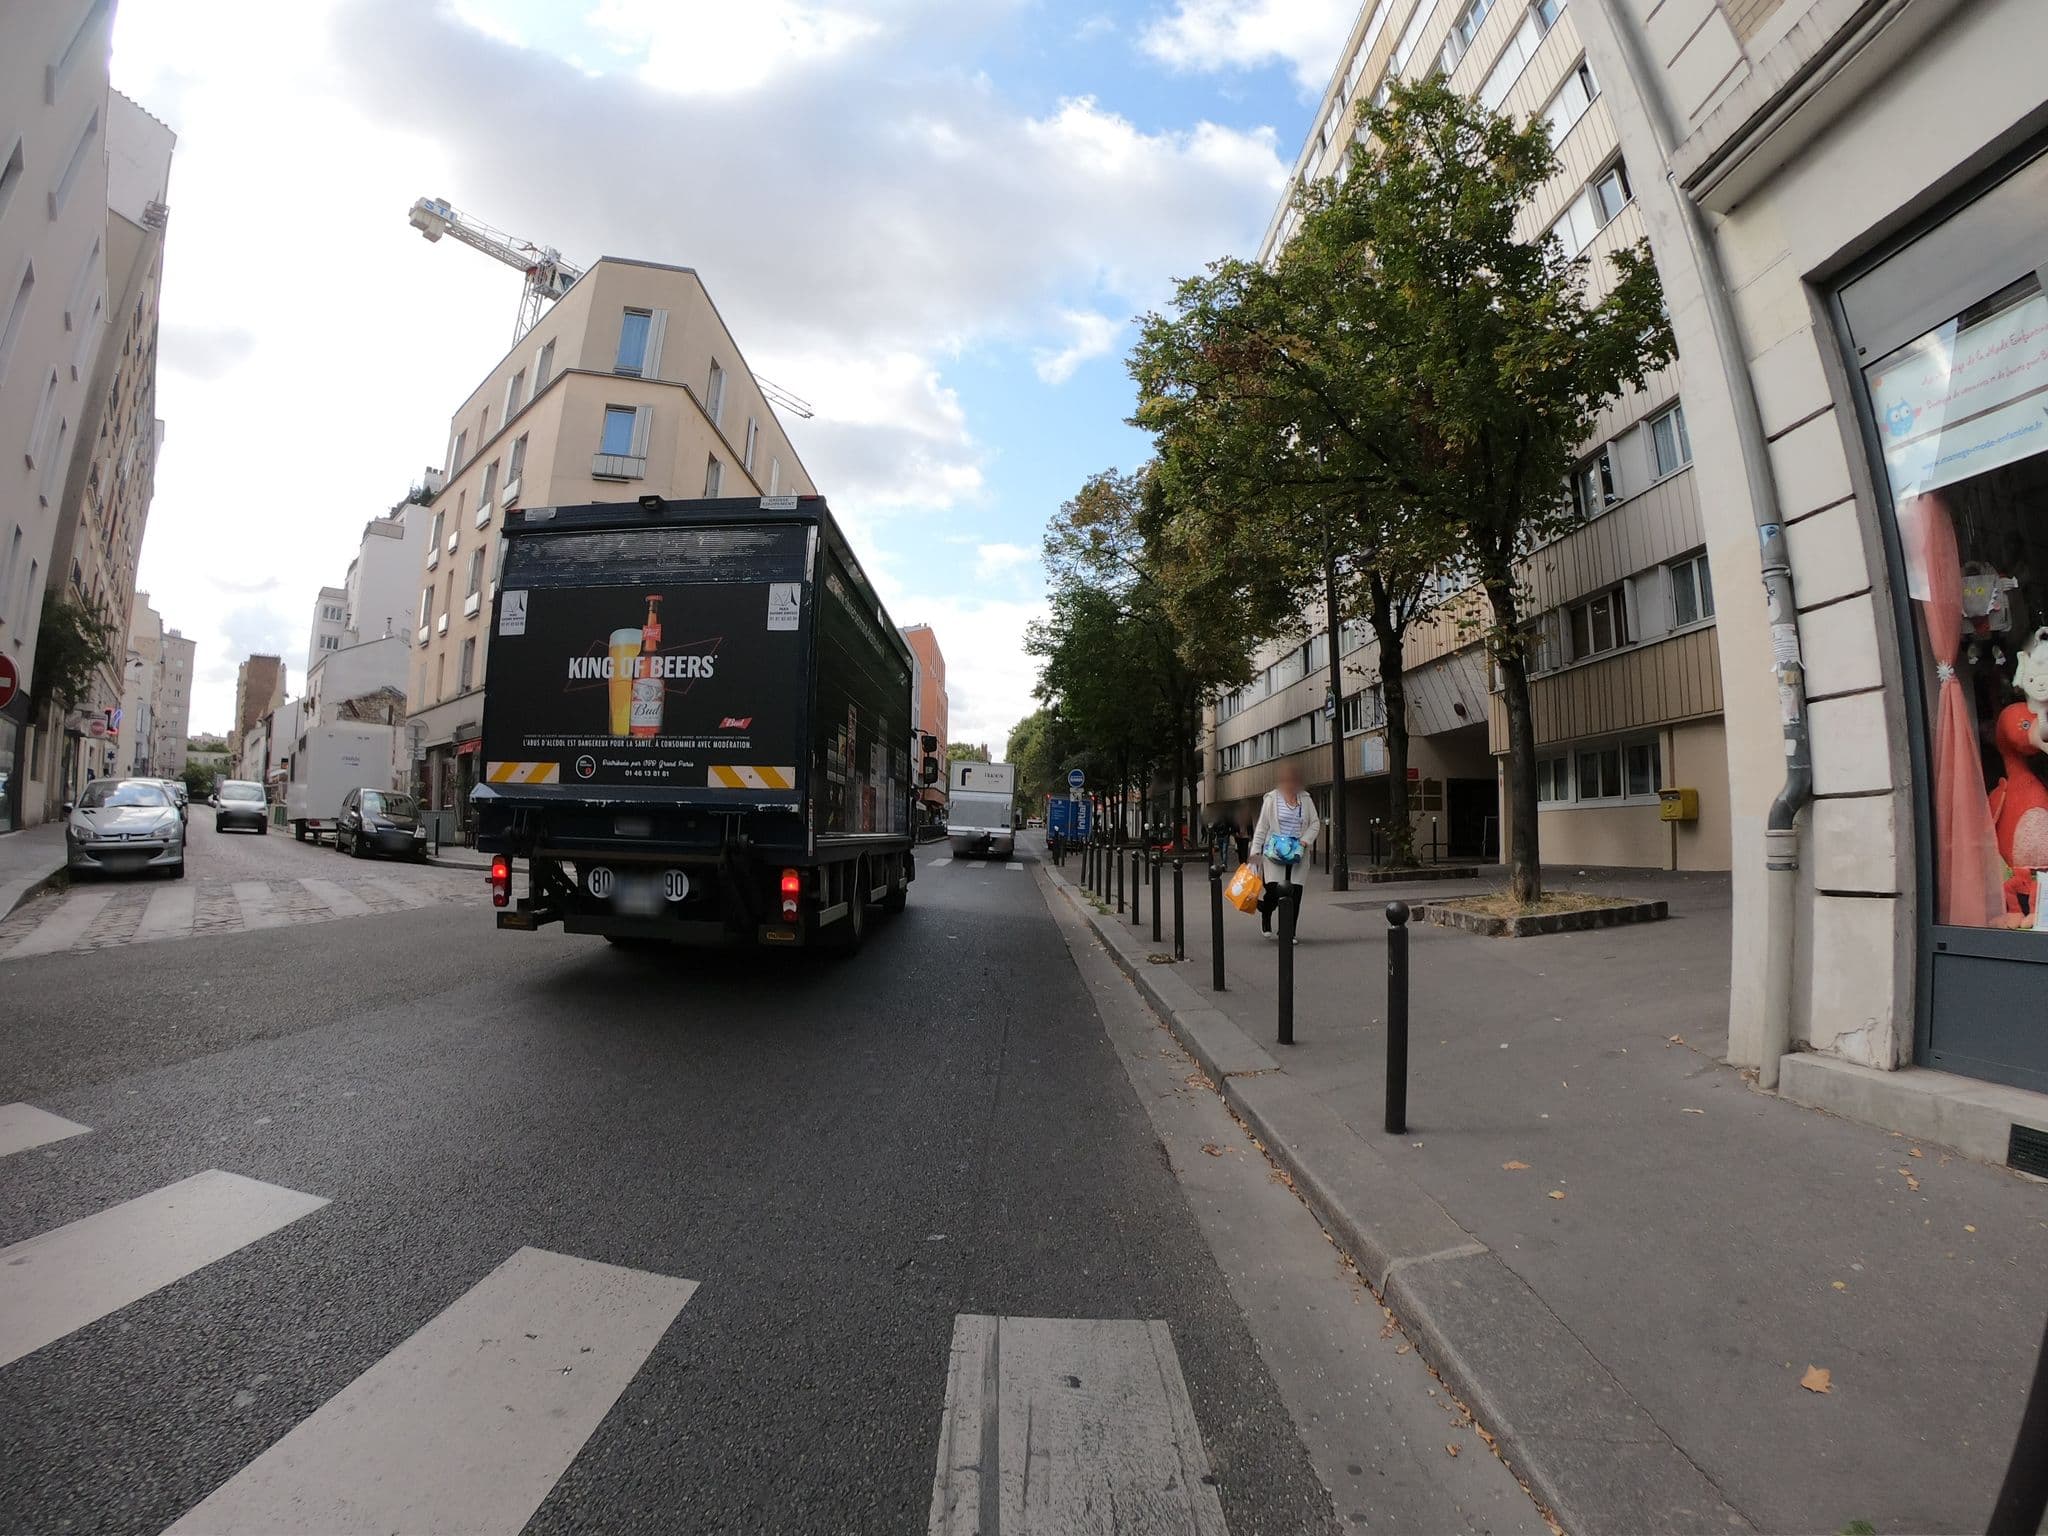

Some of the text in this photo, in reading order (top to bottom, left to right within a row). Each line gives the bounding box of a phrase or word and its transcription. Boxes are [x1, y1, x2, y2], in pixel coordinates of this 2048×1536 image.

[568, 655, 714, 679] KING OF BEERS
[633, 703, 661, 716] Bud
[567, 739, 576, 747] EST
[578, 739, 608, 748] DANGEREUX
[610, 739, 624, 748] POUR
[626, 740, 633, 748] LA
[661, 740, 696, 748] CONSOMMER
[697, 740, 711, 748] AVEC
[592, 869, 611, 895] 80
[664, 872, 684, 897] 90
